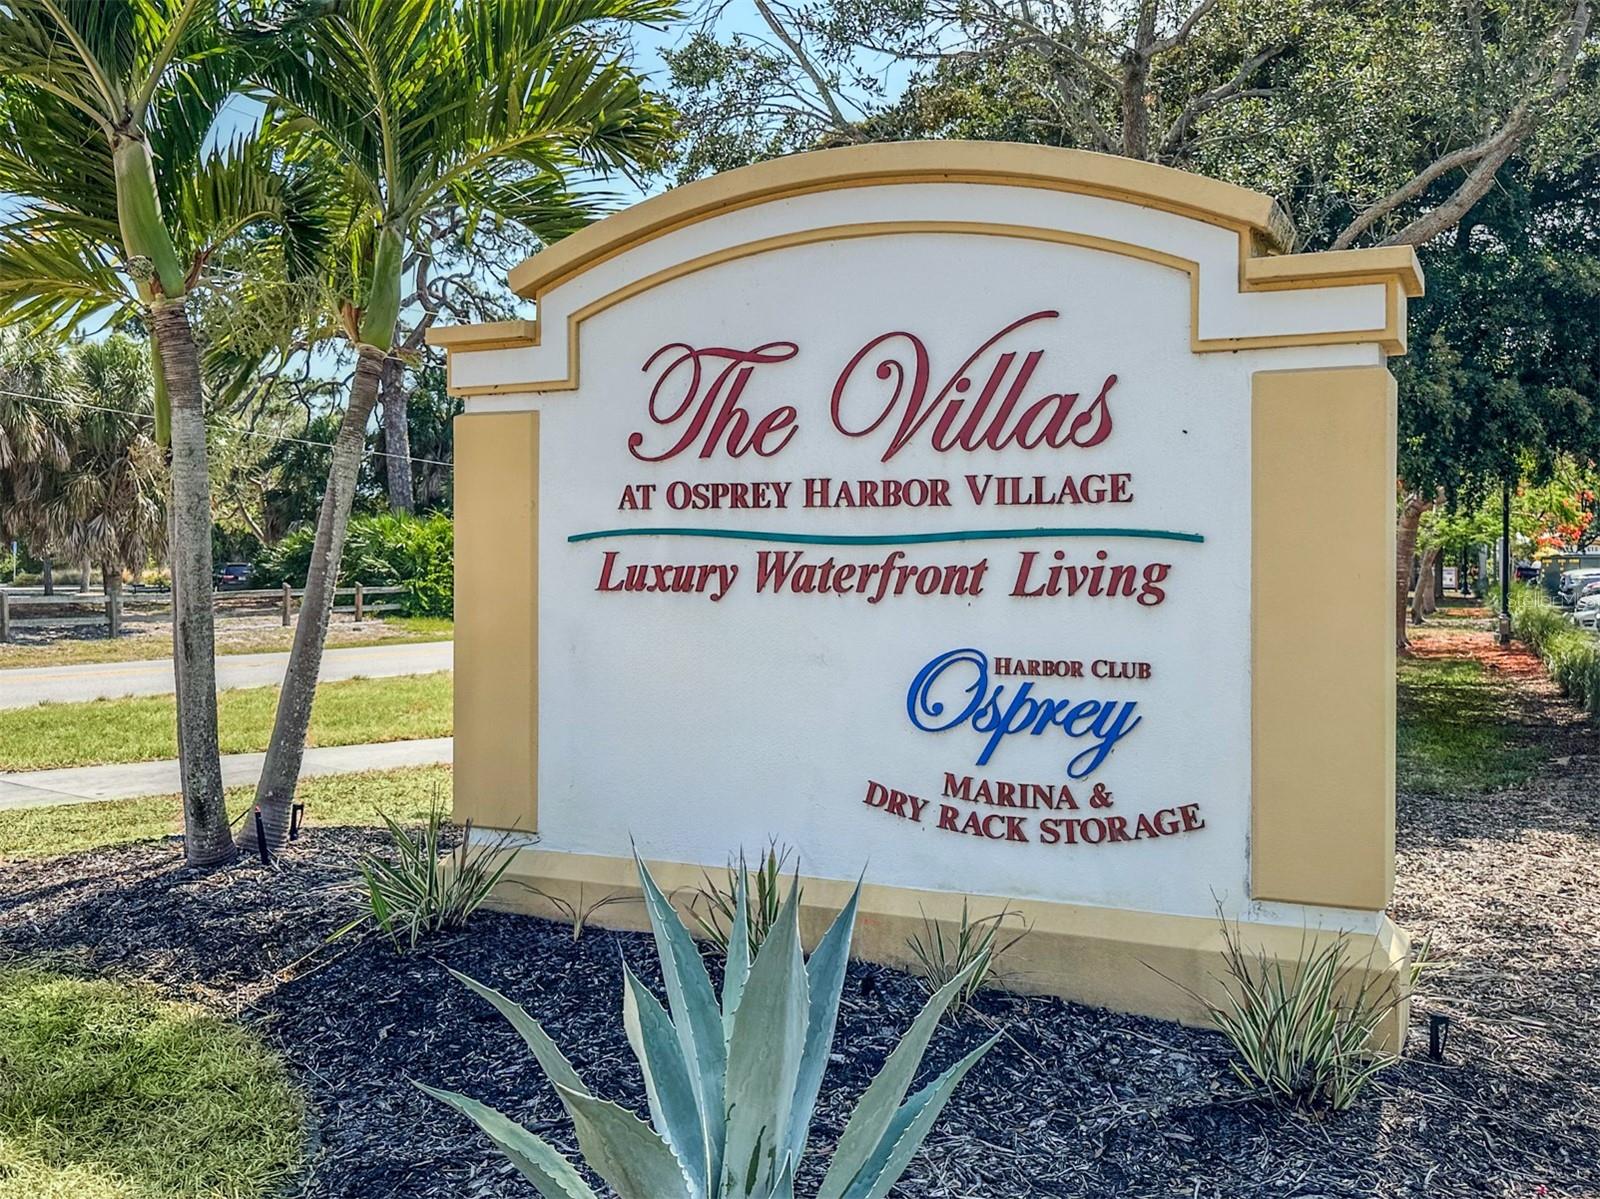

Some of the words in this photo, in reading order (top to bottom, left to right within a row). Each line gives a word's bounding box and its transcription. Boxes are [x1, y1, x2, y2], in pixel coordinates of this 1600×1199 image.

[629, 341, 799, 462] The
[831, 310, 1117, 463] Villas
[618, 485, 656, 510] AT
[667, 481, 792, 510] OSPREY
[803, 478, 952, 508] HARBOR
[964, 473, 1134, 505] VILLAGE
[595, 551, 738, 602] Luxury
[756, 551, 989, 604] Waterfront
[1010, 550, 1172, 606] Living
[994, 657, 1083, 678] HARBOR
[1091, 659, 1152, 679] CLUB
[906, 648, 1142, 779] Osprey
[862, 780, 930, 822] DRY
[936, 804, 1030, 843] RACK
[1040, 803, 1206, 844] STORAGE
[941, 772, 1079, 810] MARINA
[1089, 782, 1114, 809] &
